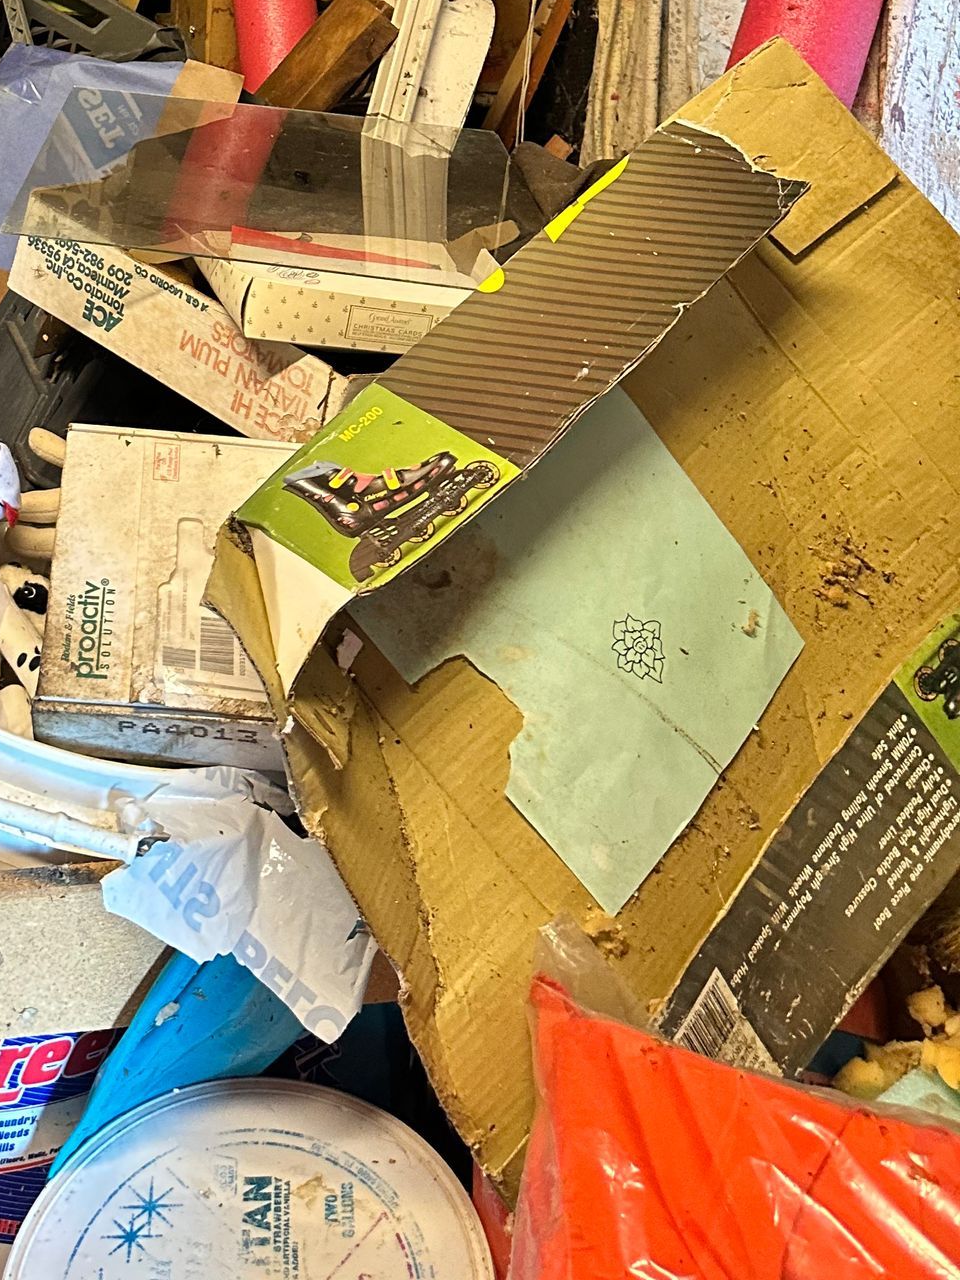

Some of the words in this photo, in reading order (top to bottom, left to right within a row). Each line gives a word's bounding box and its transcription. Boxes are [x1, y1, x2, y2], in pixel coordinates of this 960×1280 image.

[28, 236, 61, 262] 95336
[107, 264, 133, 286] 209
[134, 264, 149, 278] CO.
[149, 274, 184, 299] LAGORIO
[84, 283, 125, 317] Tomato
[185, 292, 200, 308] G.B.
[200, 304, 210, 312] A
[83, 298, 123, 332] ACE
[353, 324, 395, 335] CHRISTMAS
[179, 330, 231, 377] PLUM
[212, 321, 313, 397] TOMATOES
[234, 363, 308, 419] ITALIAN
[231, 390, 253, 420] HI
[339, 406, 383, 442] MC-200
[67, 594, 76, 620] Fields
[64, 620, 72, 631] &
[76, 581, 107, 679] proactiv
[100, 588, 116, 670] SOLUTION
[61, 633, 74, 662] Rodan
[118, 721, 258, 744] PA4013
[887, 719, 904, 740] Rink
[872, 740, 888, 760] Safe
[891, 732, 913, 761] 70MM
[866, 759, 893, 791] Smooth
[884, 746, 922, 795] Constructed
[906, 759, 930, 789] Chassis
[922, 771, 940, 793] Fully
[842, 791, 867, 821] Rolling
[875, 793, 883, 807] of
[930, 784, 949, 807] Dual
[856, 806, 876, 828] Ultra
[896, 793, 923, 828] Padded
[914, 803, 933, 825] High
[919, 796, 957, 846] Lightweight
[812, 823, 844, 862] Urethane
[839, 829, 857, 851] High
[879, 826, 897, 849] Liner
[899, 826, 916, 846] Tech
[877, 846, 900, 875] Buckle
[910, 845, 919, 856] &
[789, 865, 817, 896] Wheels
[887, 857, 912, 890] Vented
[910, 864, 923, 881] one
[845, 878, 877, 917] Clossures
[891, 882, 911, 906] Piece
[771, 902, 788, 924] With
[777, 890, 812, 931] Polymers
[874, 907, 892, 930] Boot
[748, 925, 772, 962] Spoked
[731, 962, 748, 987] Hubs
[273, 1177, 283, 1252] STRAWBERRY
